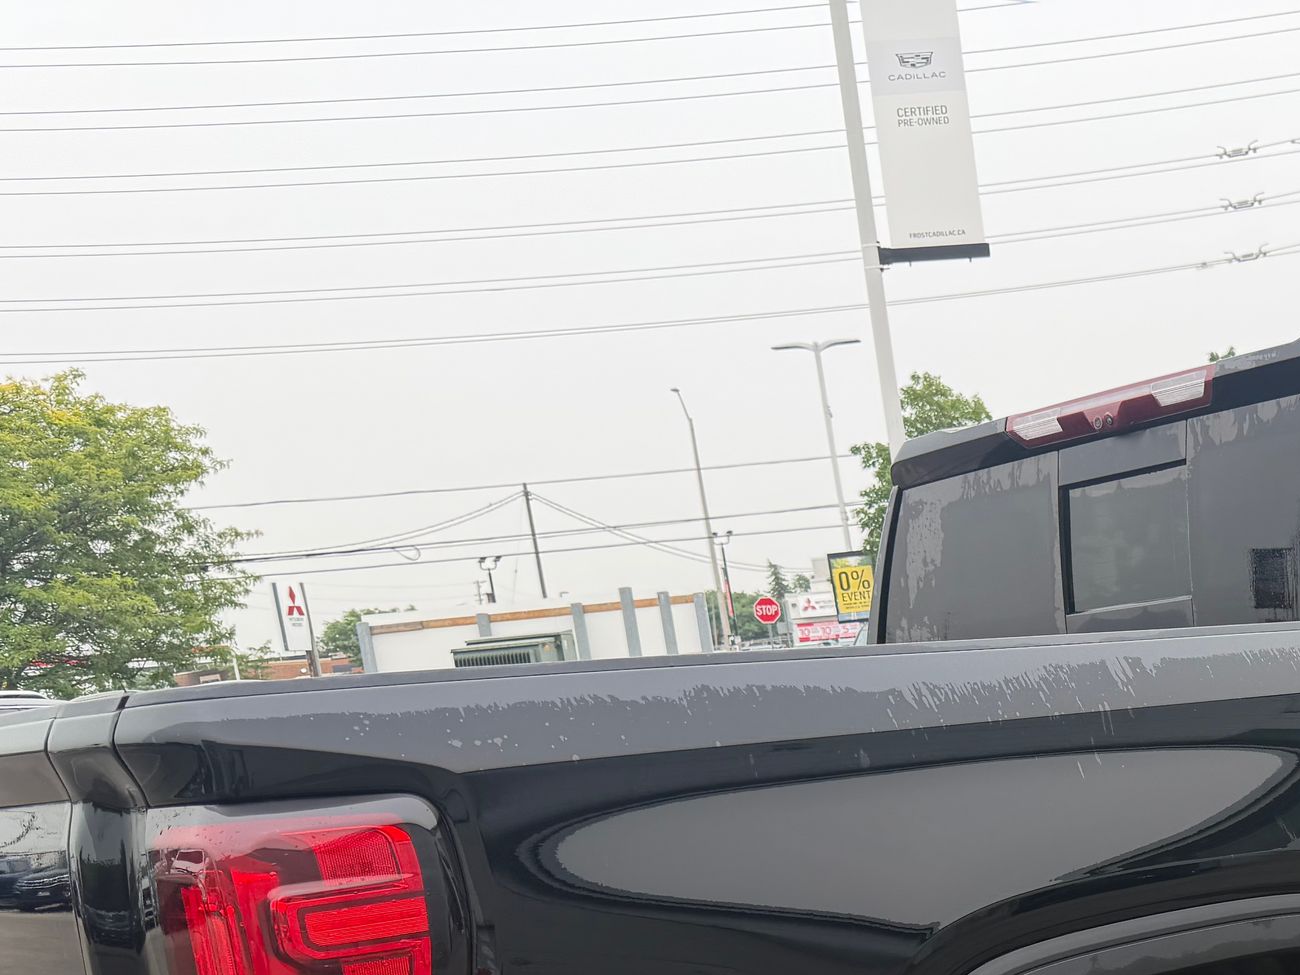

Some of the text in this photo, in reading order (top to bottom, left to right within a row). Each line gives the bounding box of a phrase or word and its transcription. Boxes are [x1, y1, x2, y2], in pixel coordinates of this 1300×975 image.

[888, 71, 946, 81] CADILLAC
[897, 105, 948, 118] CERTIFIED
[898, 116, 950, 127] PRE-OWNED
[838, 569, 871, 591] 0%
[841, 590, 871, 602] EVENT
[756, 604, 778, 615] STOP
